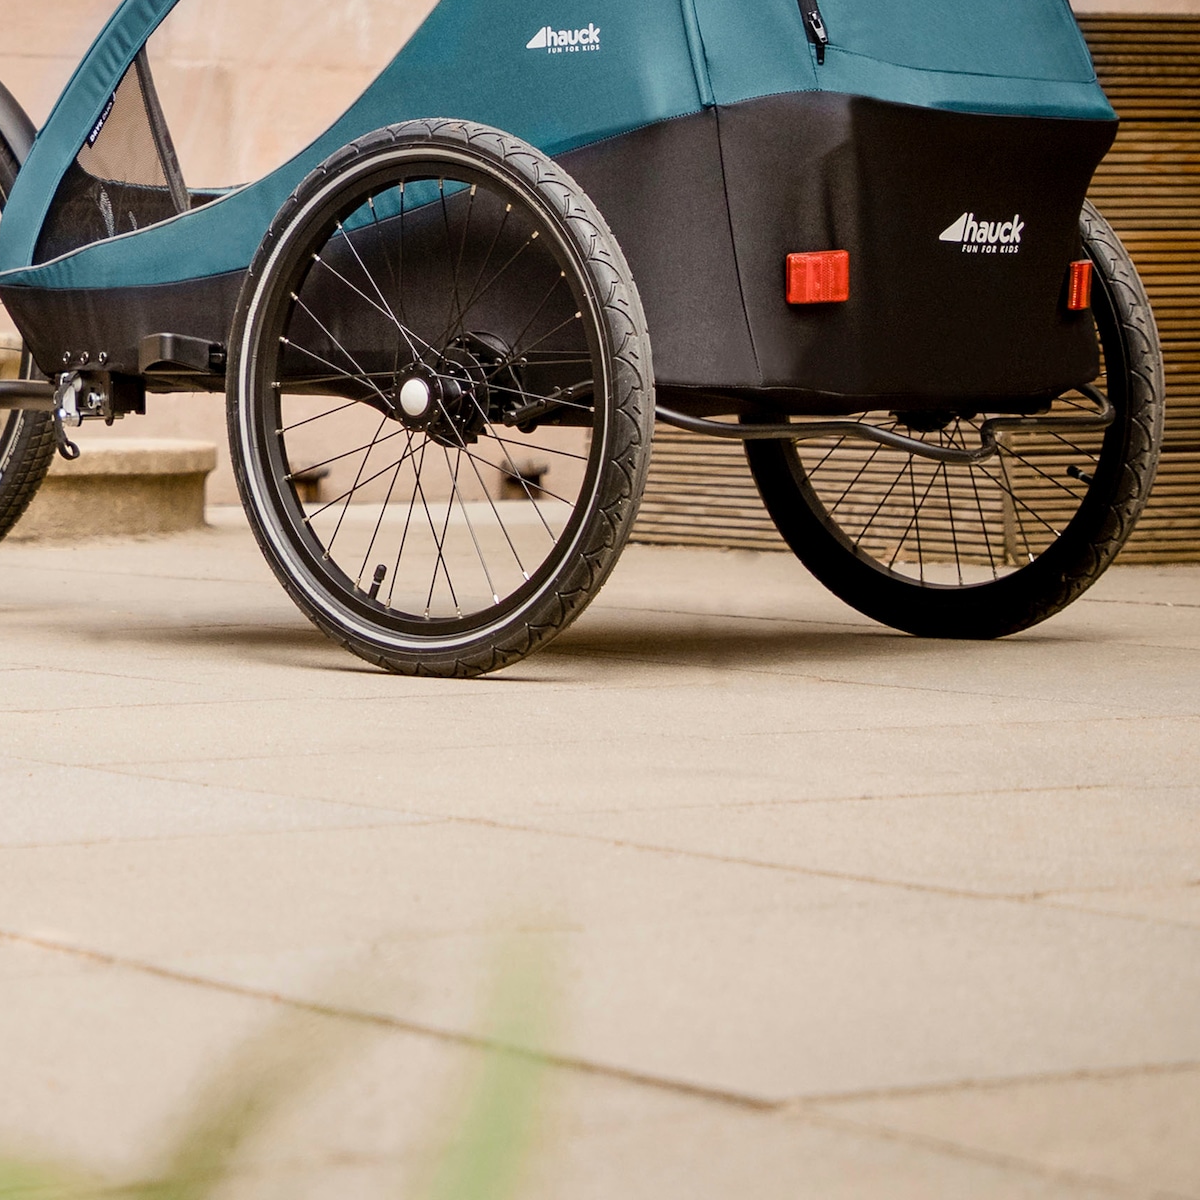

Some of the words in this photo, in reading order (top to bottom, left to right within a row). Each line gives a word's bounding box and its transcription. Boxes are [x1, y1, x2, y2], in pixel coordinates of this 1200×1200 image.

[547, 22, 601, 47] hauck
[963, 212, 1025, 243] hauck
[961, 244, 978, 253] FUN
[981, 244, 997, 253] FOR
[999, 245, 1019, 253] KIDS
